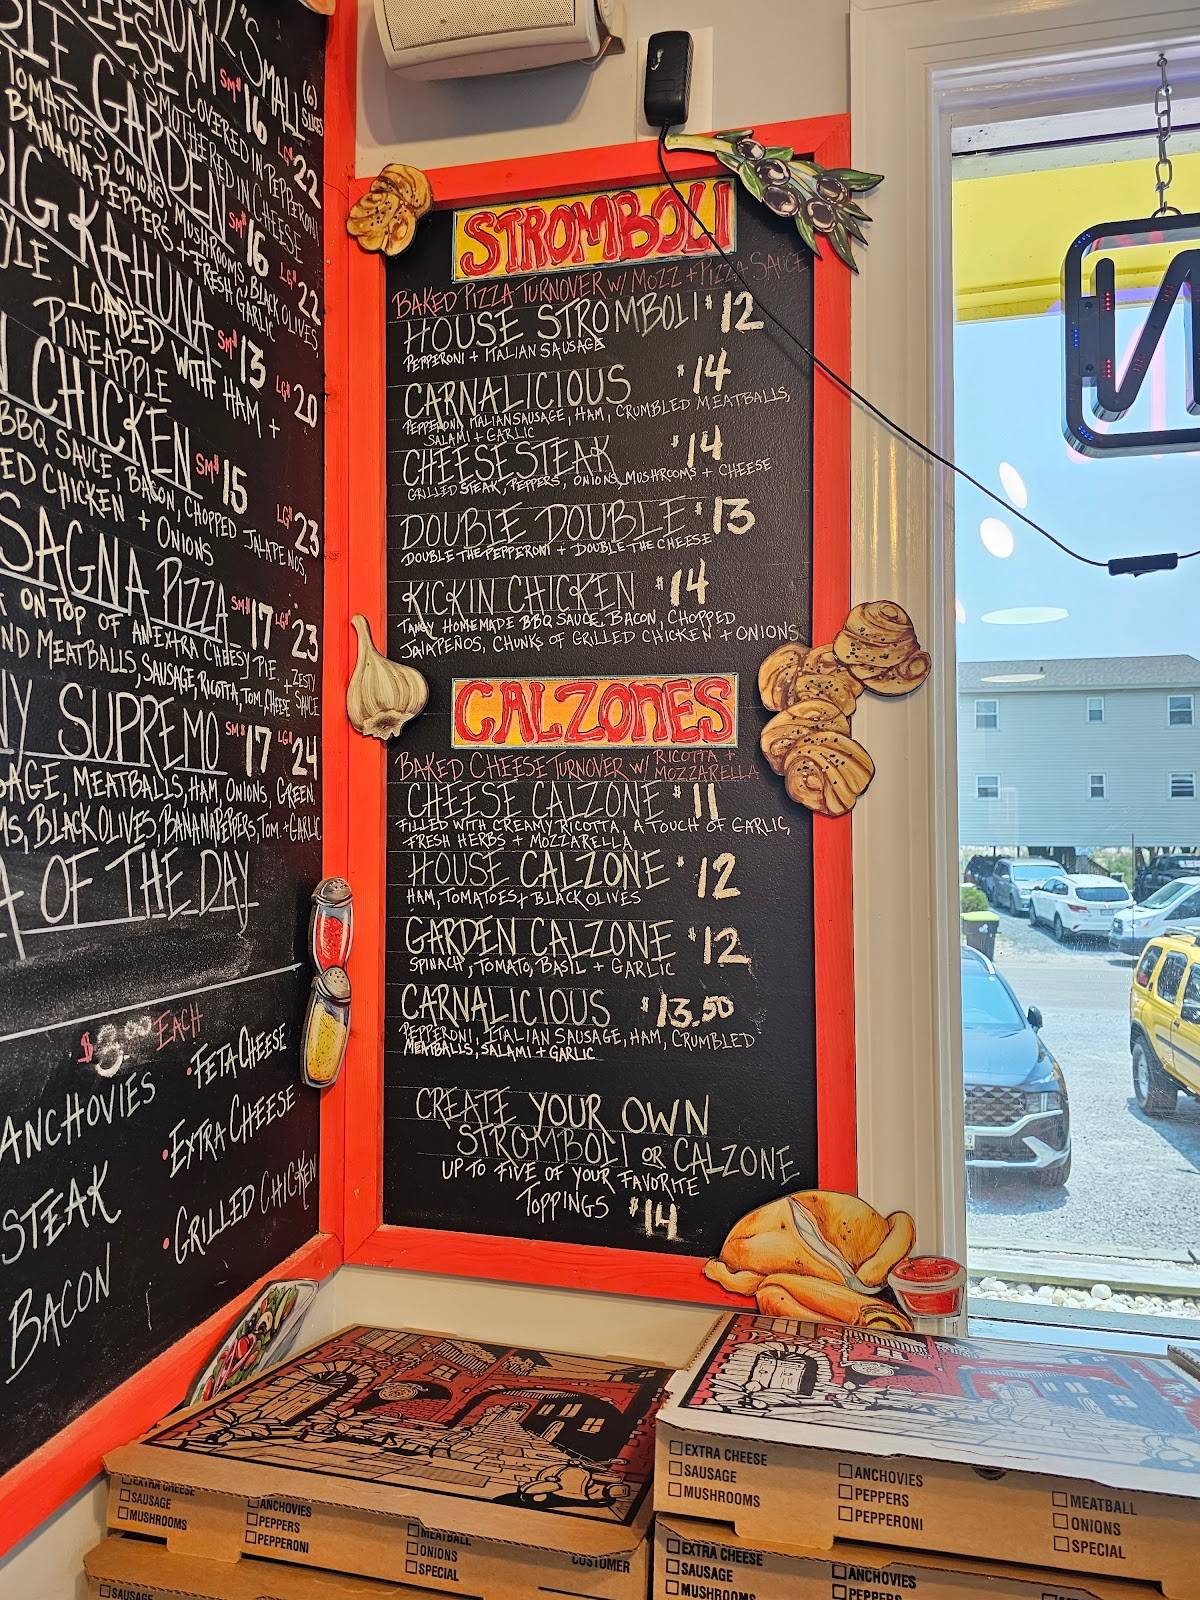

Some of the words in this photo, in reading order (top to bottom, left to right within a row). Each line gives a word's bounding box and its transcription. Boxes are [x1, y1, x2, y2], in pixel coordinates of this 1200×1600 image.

[239, 17, 306, 141] SMALL
[186, 70, 249, 163] COVERED
[251, 147, 263, 181] IN
[92, 53, 227, 243] GARDEN
[143, 71, 235, 188] SMOTHERED
[237, 175, 250, 212] IN
[253, 182, 303, 264] CHEESE
[5, 88, 95, 191] BANANA
[189, 249, 233, 305] FRESH
[236, 286, 276, 343] GARLIC
[459, 180, 732, 278] STROMBOLI
[250, 275, 281, 326] BLACK
[392, 286, 458, 320] BAKED
[456, 282, 515, 312] PIZZA
[514, 271, 607, 309] TURNOVER
[631, 266, 683, 293] MOZZ
[750, 251, 809, 281] SAUCE
[404, 305, 524, 355] HOUSE
[537, 291, 698, 345] STROMBOLI
[33, 296, 173, 403] PINEAPPLE
[403, 351, 465, 373] PEPPERONI
[485, 343, 537, 363] ITALIAN
[32, 336, 192, 490] CHICKEN
[223, 375, 262, 438] HAM
[405, 364, 632, 422] CARNALICIOUS
[616, 397, 691, 421] CRUMBLED
[424, 430, 471, 447] SALAMI
[486, 427, 535, 442] GARLIC
[407, 484, 458, 501] GRILLED
[718, 457, 773, 479] CHEESE
[42, 463, 126, 523] CHICKEN
[157, 515, 214, 567] ONIONS
[184, 496, 237, 538] CHOPPED
[400, 502, 527, 550] DOUBLE
[534, 495, 686, 546] DOUBLE
[401, 549, 455, 567] DOUBLE
[570, 540, 627, 556] DOUBLE
[657, 532, 713, 550] CHEESE
[155, 557, 230, 650] PIZZA
[402, 579, 495, 623] KICKIN
[507, 572, 635, 618] CHICKEN
[20, 587, 47, 619] ON
[48, 597, 87, 636] TOP
[97, 612, 125, 639] OF
[152, 626, 200, 659] EXTRA
[442, 616, 515, 634] HOMEMADE
[519, 612, 553, 631] BBQ
[667, 609, 736, 628] CHOPPED
[493, 633, 544, 653] CHUNKS
[549, 632, 566, 649] OF
[572, 629, 636, 648] GRILLED
[642, 626, 713, 646] CHICKEN
[736, 621, 800, 642] ONIONS
[58, 682, 220, 780] SUPREMO
[395, 751, 465, 783] BAKED
[469, 751, 548, 780] CHEESE
[546, 751, 629, 783] TURNOVER
[653, 750, 718, 764] RICOTTA
[654, 764, 760, 782] MOZZARELLA
[408, 778, 523, 822] CHEESE
[532, 779, 665, 823] CALZONE
[27, 802, 98, 849] BLACK
[396, 818, 449, 834] FILLED
[453, 819, 487, 833] WITH
[493, 818, 553, 836] CREAMY
[644, 818, 700, 834] TOUCH
[706, 817, 727, 833] OF
[403, 833, 451, 849] FRESH
[458, 832, 506, 850] HERBS
[530, 833, 633, 851] MOZZARELLA
[41, 847, 99, 927] OF
[104, 842, 191, 922] THE
[199, 849, 250, 937] DAY
[408, 848, 510, 891] HOUSE
[520, 848, 671, 893] CALZONE
[530, 890, 589, 911] BLACK
[586, 890, 642, 906] OLIVES
[406, 915, 517, 958] GARDEN
[531, 916, 677, 961] CALZONE
[535, 955, 587, 977] BASIL
[611, 958, 676, 979] GARLIC
[153, 1001, 204, 1051] EACH
[402, 983, 611, 1029] CARNALICIOUS
[190, 1043, 239, 1090] FETA
[238, 1022, 287, 1070] CHEESE
[481, 1043, 532, 1062] SALAMI
[549, 1046, 597, 1062] GARLIC
[483, 1025, 551, 1045] ITALIAN
[671, 1029, 756, 1051] CRUMBLED
[0, 1071, 156, 1165] ANCHOVIES
[168, 1118, 227, 1179] EXTRA
[229, 1084, 296, 1145] CHEESE
[416, 1085, 517, 1129] CREATE
[529, 1091, 617, 1144] YOUR
[621, 1094, 710, 1136] OWN
[457, 1123, 628, 1168] STROMBOLI
[641, 1145, 667, 1170] OR
[674, 1136, 801, 1185] CALZONE
[442, 1158, 464, 1180] UP
[465, 1159, 486, 1179] TO
[494, 1160, 538, 1182] FIVE
[544, 1163, 565, 1181] OF
[572, 1165, 616, 1194] YOUR
[617, 1169, 700, 1201] FAVORITE
[2, 1159, 122, 1265] STEAK
[174, 1184, 256, 1265] GRILLED
[260, 1150, 318, 1215] CHICKEN
[516, 1180, 610, 1223] TOPPINGS
[5, 1241, 112, 1384] BACON
[684, 1443, 721, 1460] EXTRA
[724, 1450, 768, 1467] CHEESE
[684, 1464, 738, 1484] SAUSAGE
[684, 1485, 761, 1508] MUSHROOMS
[854, 1466, 924, 1488] ANCHOVIES
[855, 1488, 910, 1508] PEPPERS
[129, 1509, 188, 1531] MUSHROOMS
[131, 1491, 172, 1511] SAUSAGE
[260, 1498, 312, 1518] ANCHOVIES
[855, 1509, 924, 1531] PEPPERONI
[1070, 1494, 1139, 1517] MEATBALL
[257, 1533, 310, 1554] PEPPERONI
[259, 1515, 301, 1534] PEPPERS
[1071, 1517, 1122, 1537] ONIONS
[420, 1544, 458, 1563] ONIONS
[572, 1556, 631, 1574] CUSTOMER
[681, 1542, 717, 1559] EXTRA
[720, 1549, 764, 1567] CHEESE
[1072, 1539, 1128, 1560] SPECIAL
[418, 1563, 460, 1582] SPECIAL
[681, 1562, 734, 1583] SAUSAGE
[848, 1569, 917, 1589] ANCHOVIES
